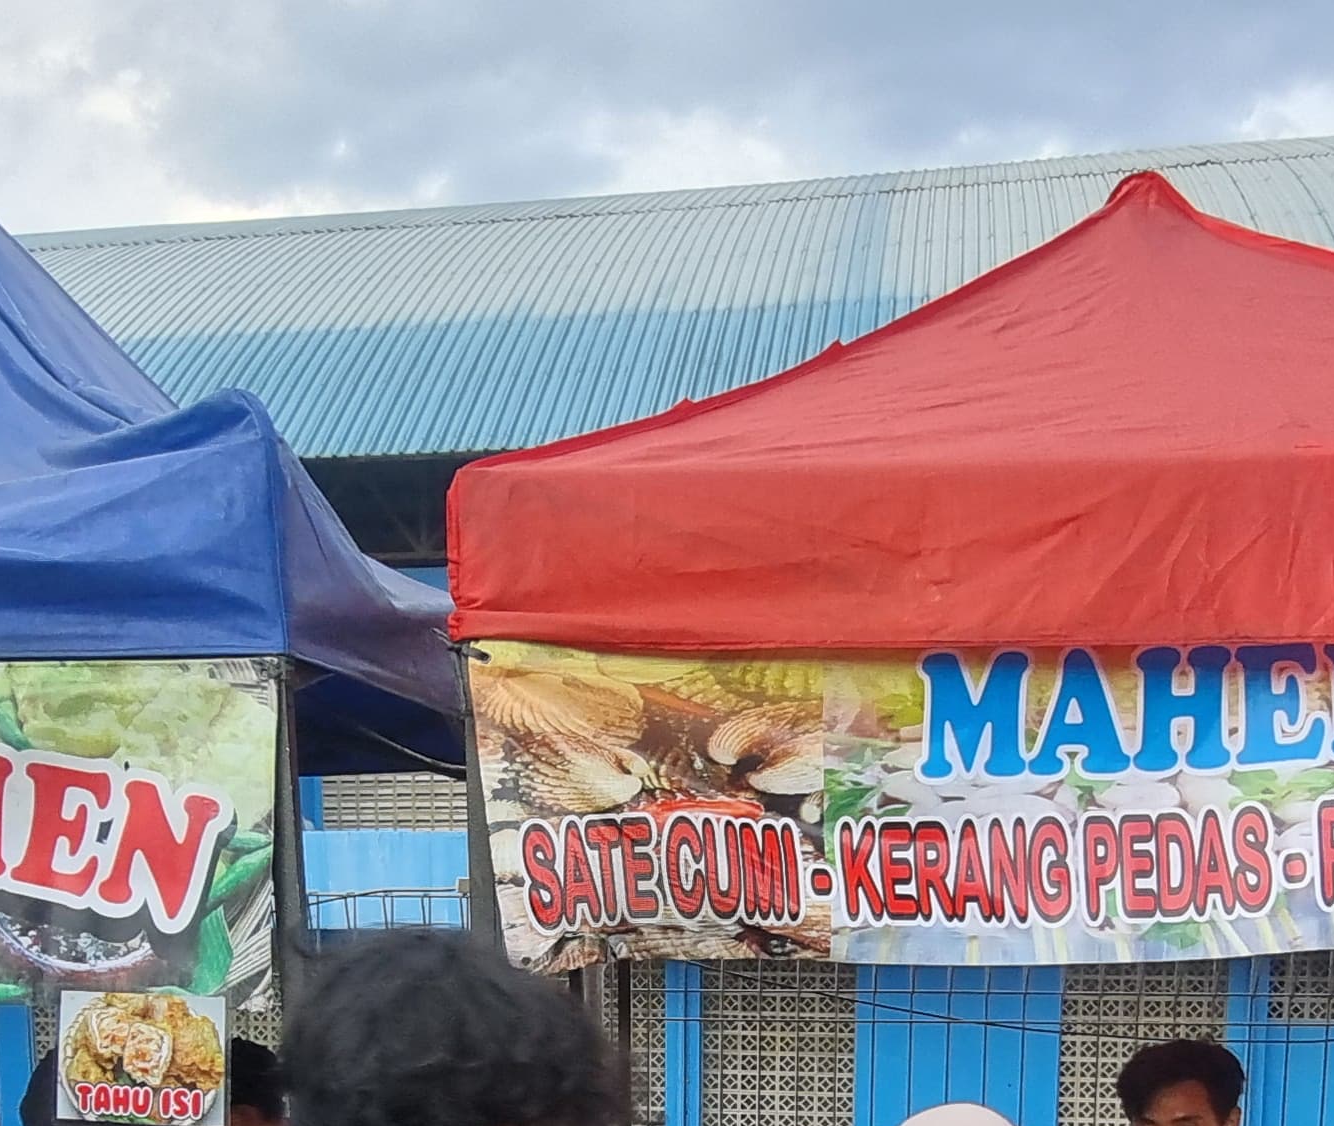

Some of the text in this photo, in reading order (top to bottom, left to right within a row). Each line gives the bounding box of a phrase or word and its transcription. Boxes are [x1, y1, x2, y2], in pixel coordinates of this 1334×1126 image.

[522, 817, 659, 930] SATE
[665, 815, 805, 924] CUMI
[837, 815, 1070, 924] KERANG
[1081, 803, 1272, 923] PEDAS
[76, 1083, 204, 1119] TAHU ISI
